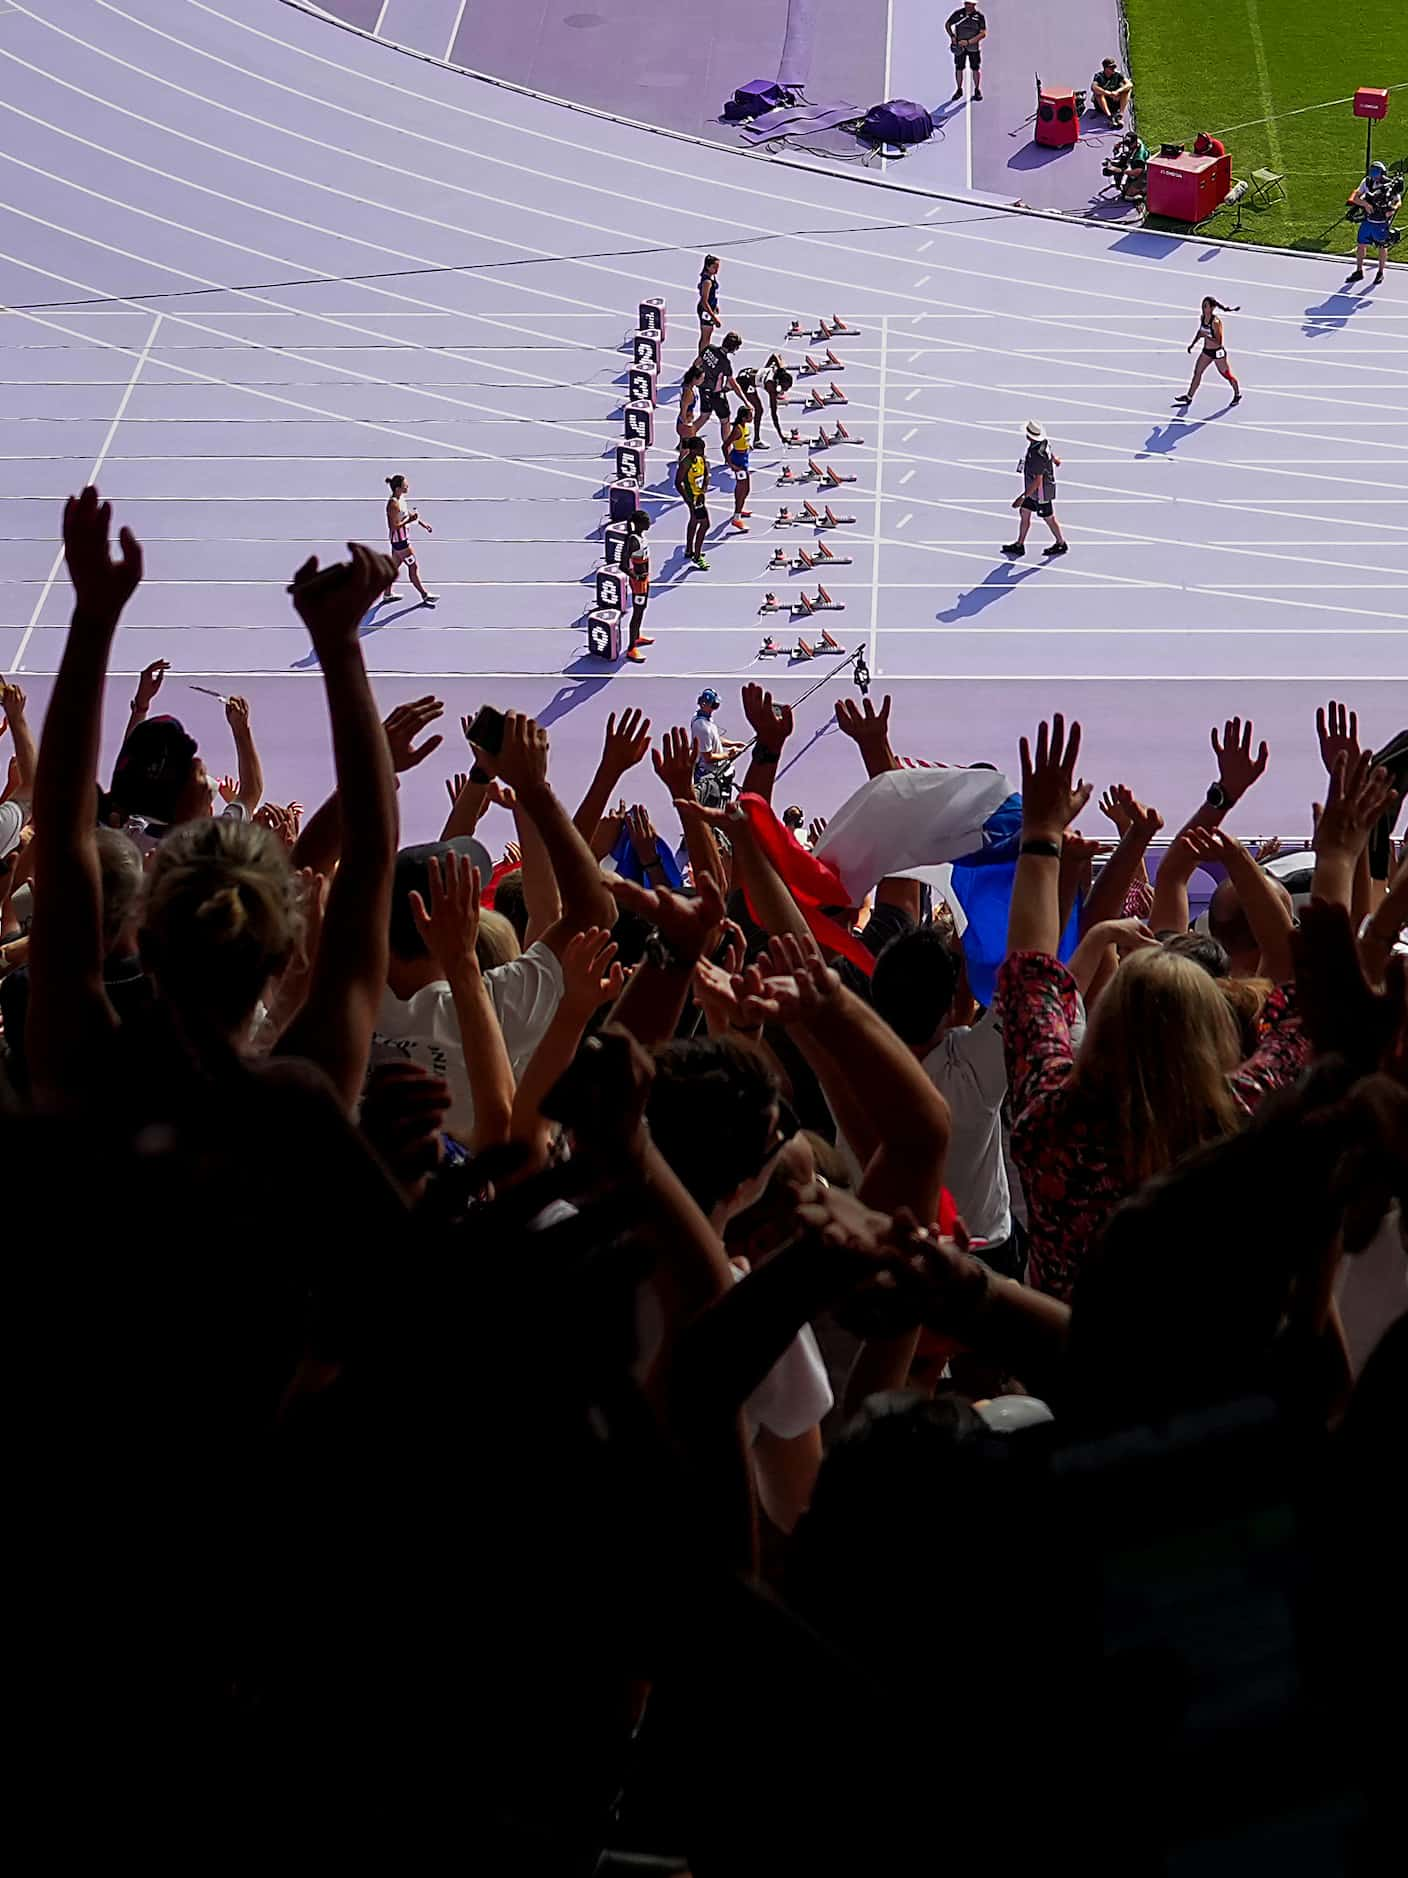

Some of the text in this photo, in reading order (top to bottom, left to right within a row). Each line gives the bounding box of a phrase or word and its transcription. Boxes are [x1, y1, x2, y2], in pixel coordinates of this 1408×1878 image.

[638, 343, 653, 364] 2
[632, 376, 649, 399] 3
[629, 414, 646, 437] 4
[621, 453, 637, 477] 5
[609, 538, 625, 562] 7
[600, 580, 619, 605] 8
[592, 626, 608, 652] 9
